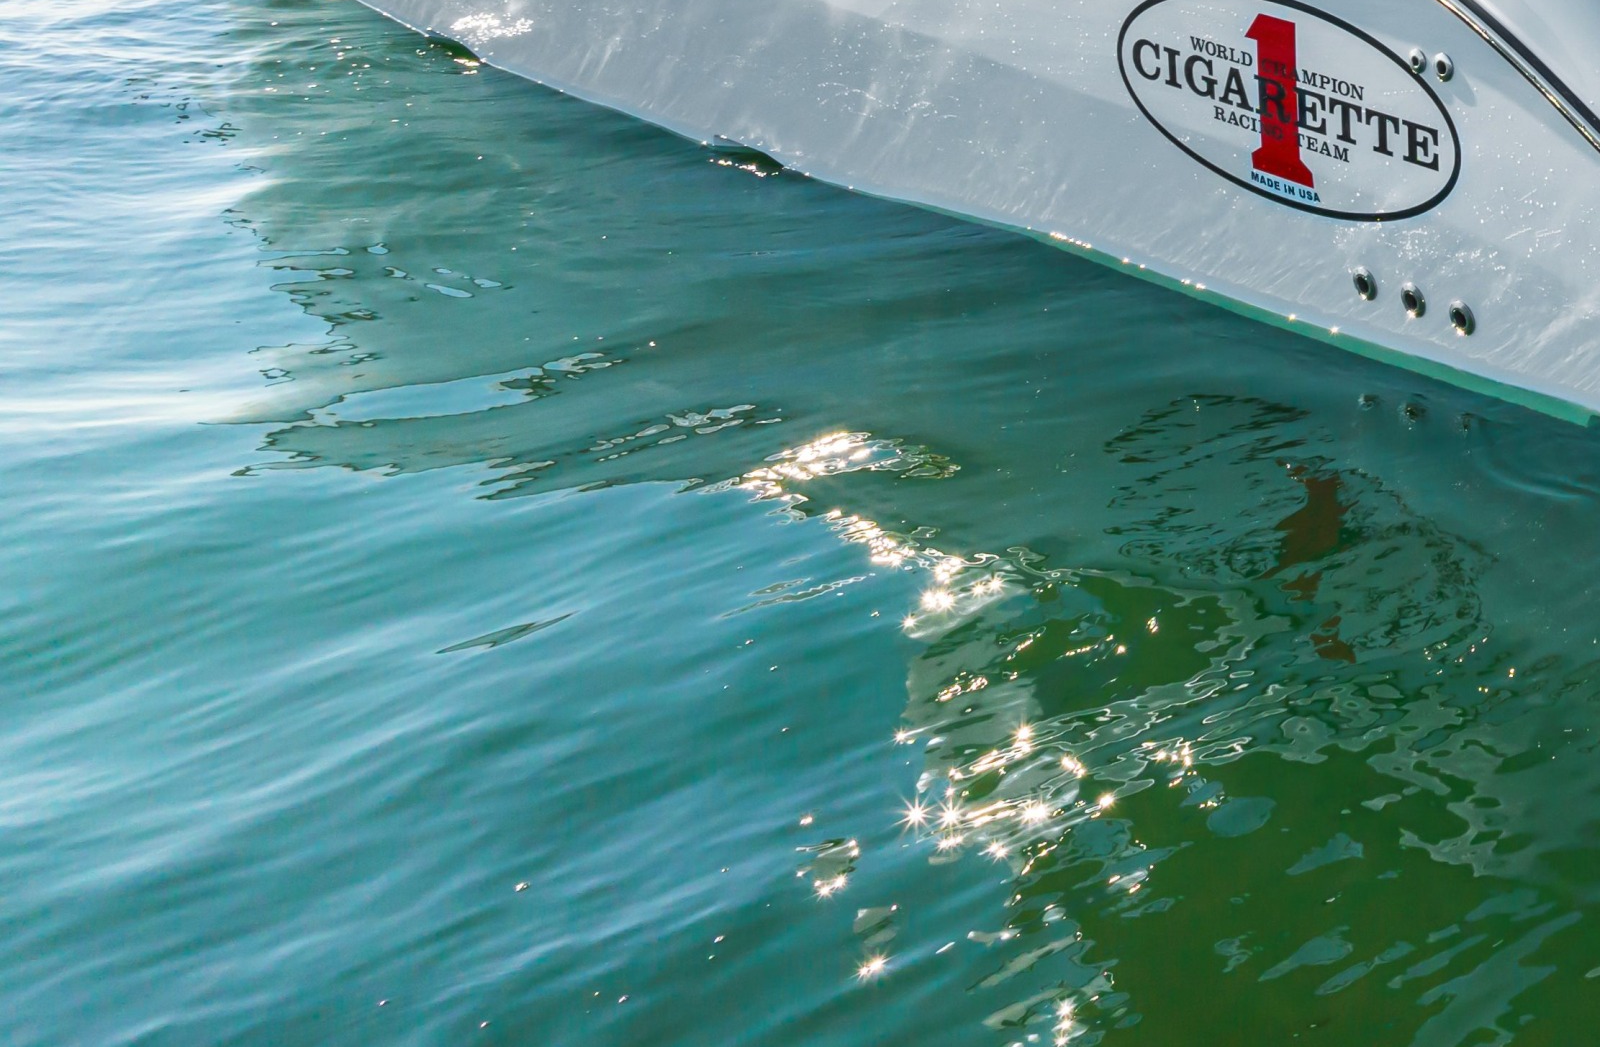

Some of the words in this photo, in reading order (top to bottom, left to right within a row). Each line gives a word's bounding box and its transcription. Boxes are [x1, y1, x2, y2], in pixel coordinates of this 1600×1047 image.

[1190, 36, 1253, 67] WORLD
[1261, 58, 1364, 101] CHAMPION
[1244, 13, 1314, 188] 1
[1132, 38, 1439, 172] CIGARETTE
[1213, 106, 1284, 142] RACING
[1294, 133, 1350, 163] TEAM
[1250, 171, 1280, 191] MADE
[1283, 183, 1295, 196] IN
[1298, 188, 1320, 202] USA
